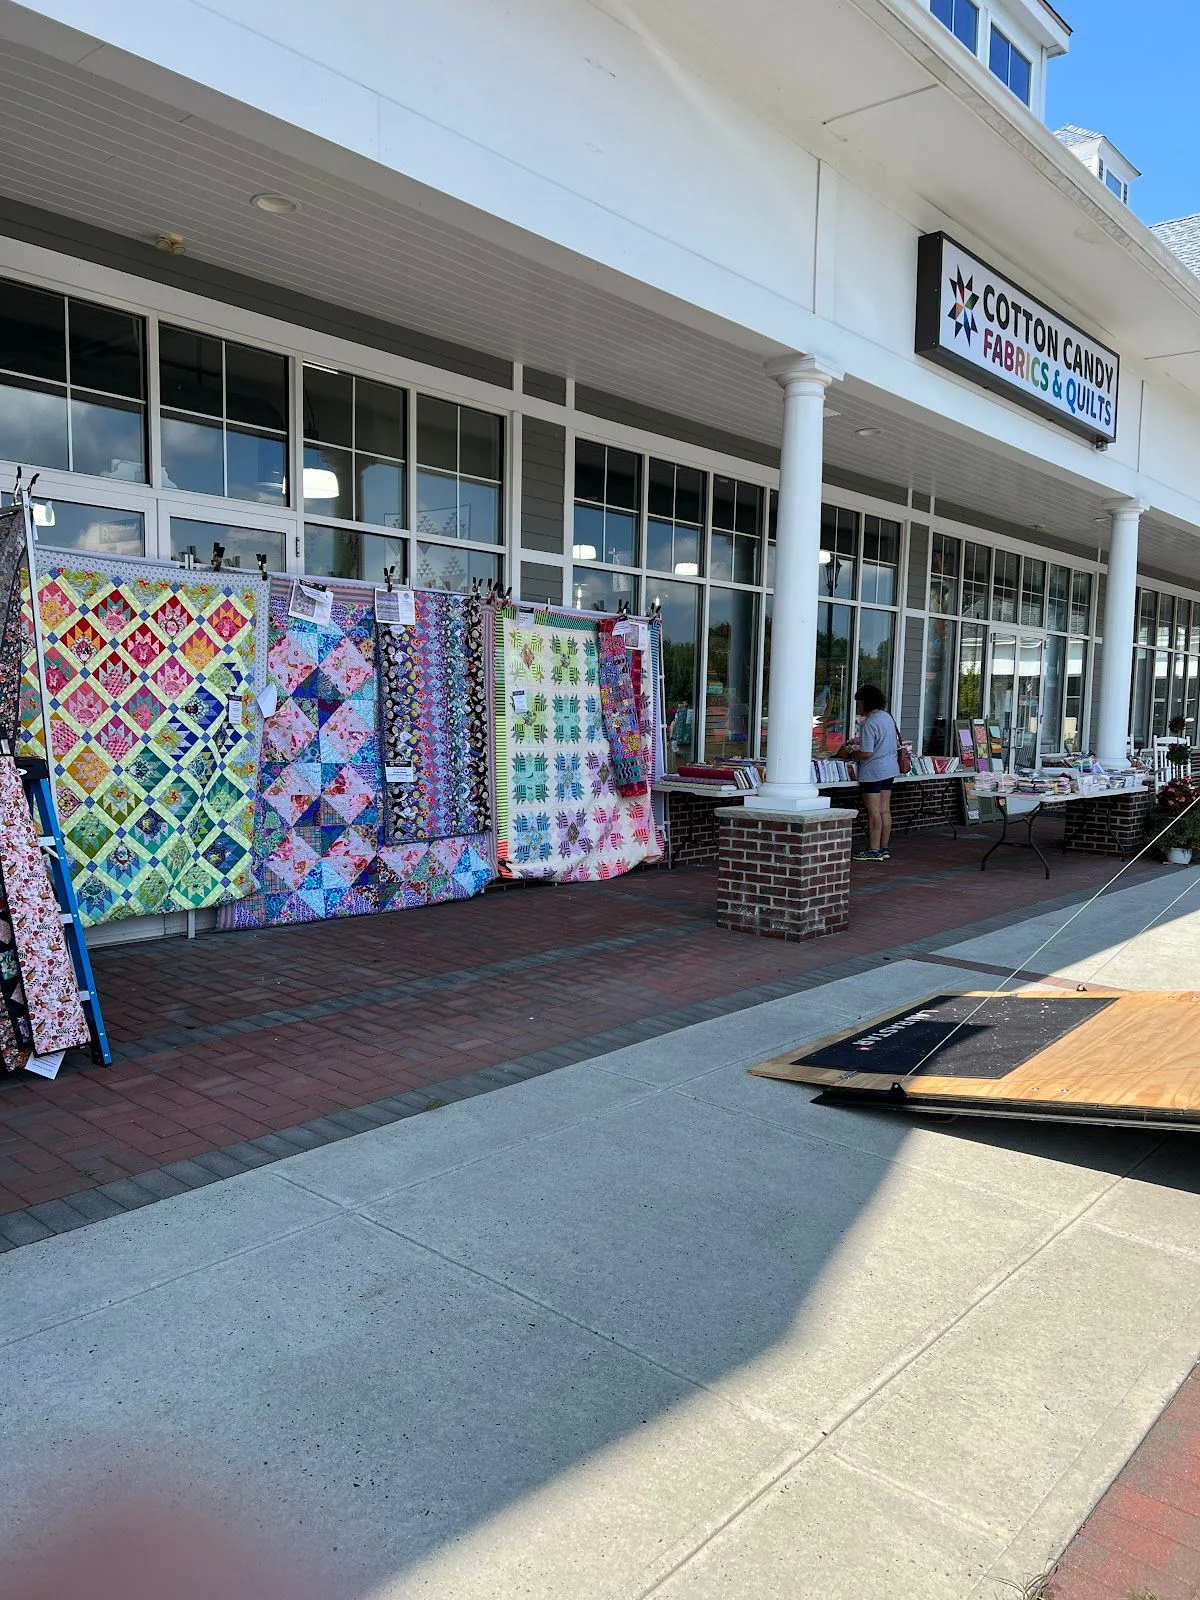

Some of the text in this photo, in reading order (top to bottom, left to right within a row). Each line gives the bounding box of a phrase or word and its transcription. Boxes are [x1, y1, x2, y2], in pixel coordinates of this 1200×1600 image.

[983, 284, 1113, 394] COTTON CANDY
[983, 328, 1111, 426] FABRICS & QUILTS
